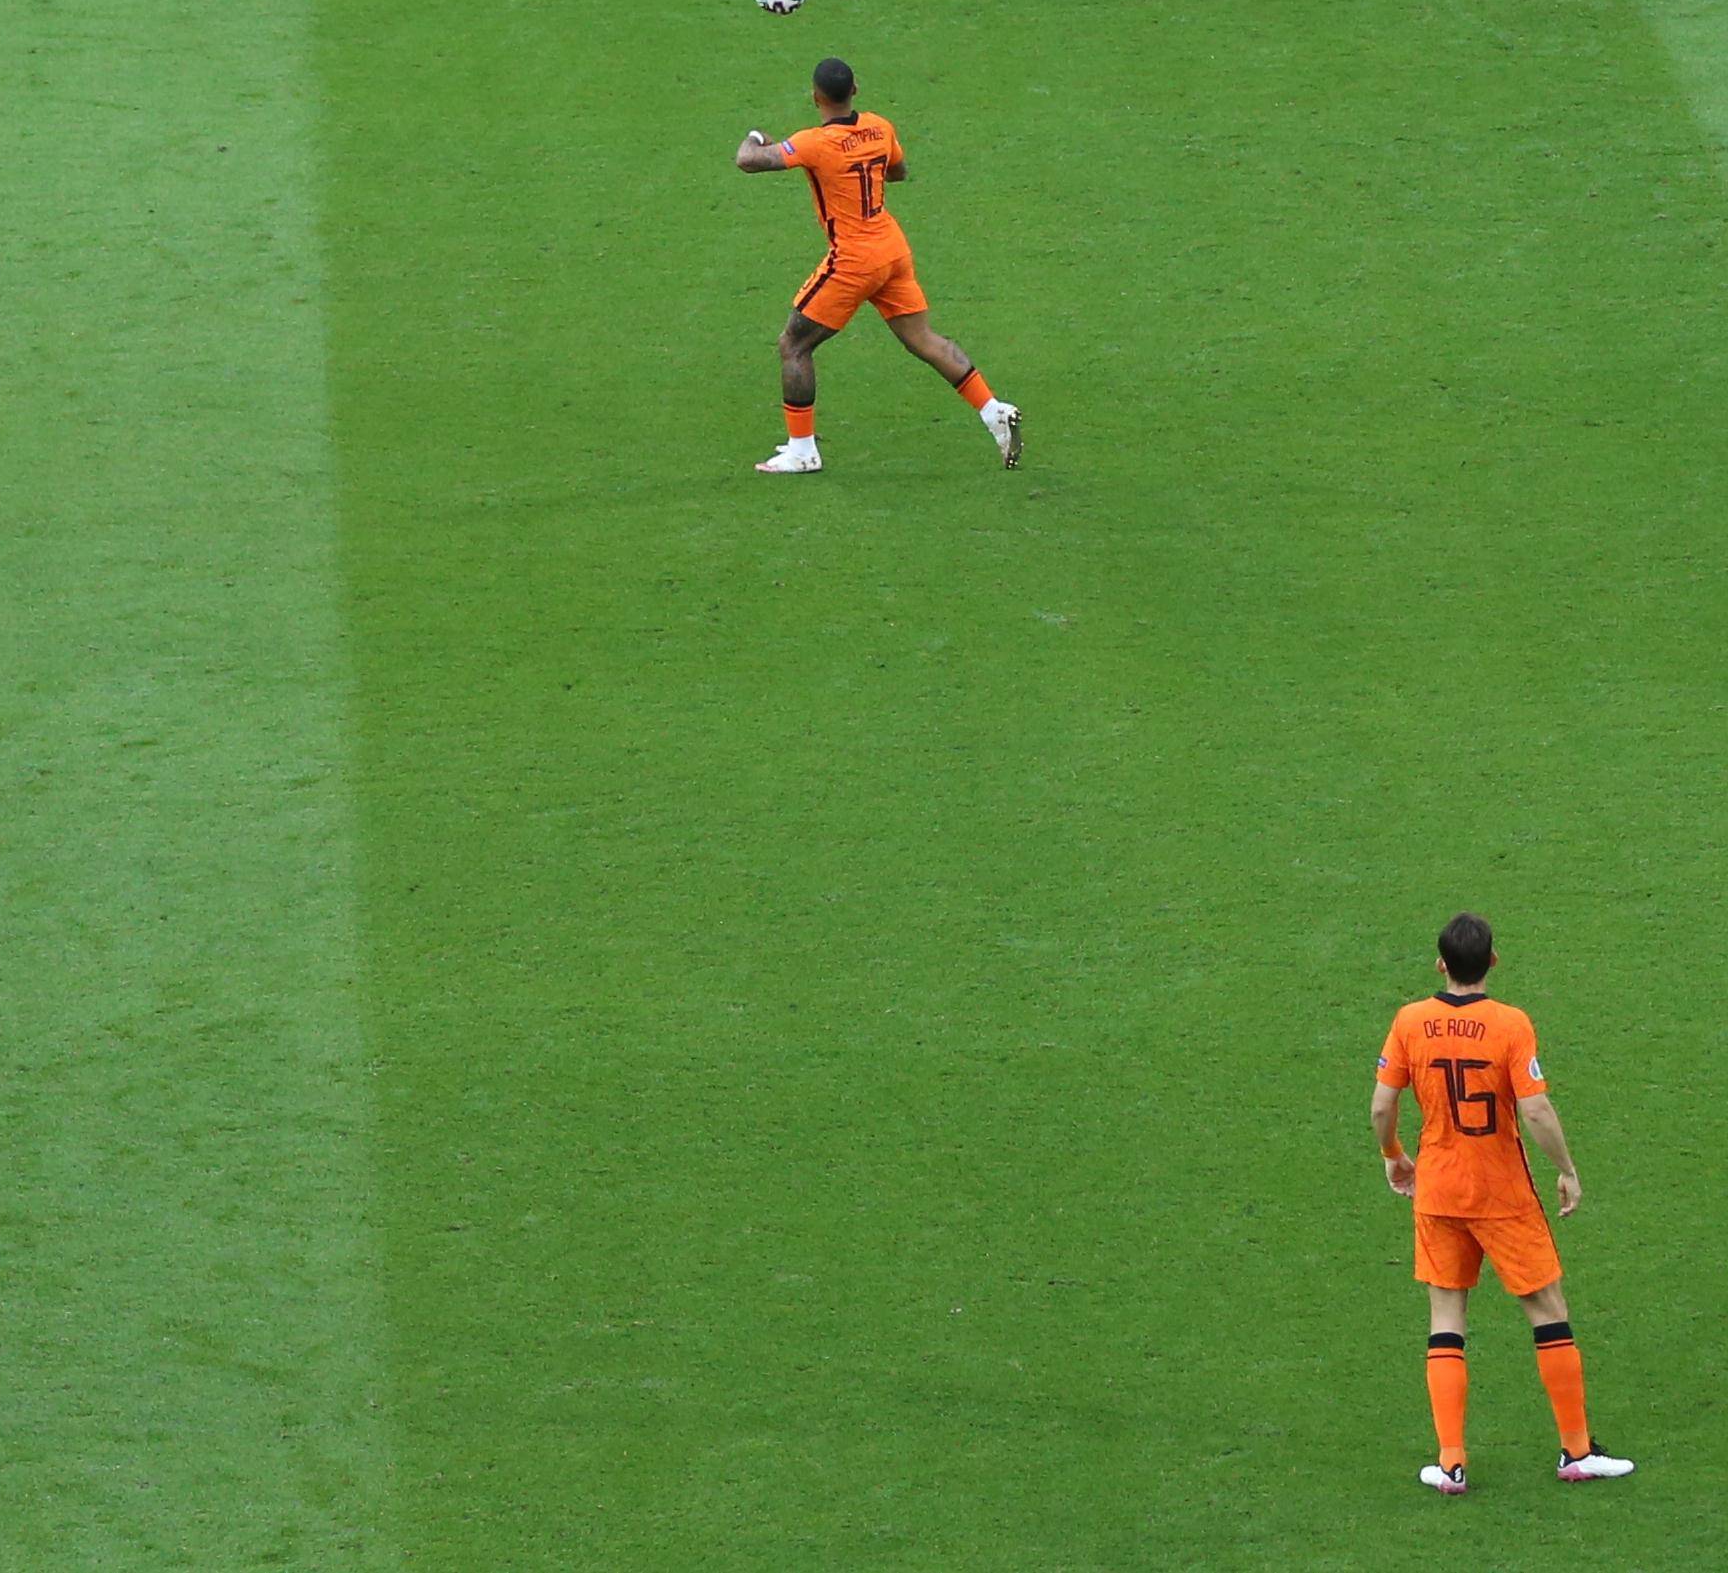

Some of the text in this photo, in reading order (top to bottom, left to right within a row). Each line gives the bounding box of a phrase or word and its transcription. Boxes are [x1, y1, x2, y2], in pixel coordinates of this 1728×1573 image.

[841, 126, 884, 153] MEMPHIS
[848, 155, 889, 220] 10
[1423, 1017, 1486, 1041] DE ROON
[1430, 1059, 1497, 1138] 15
